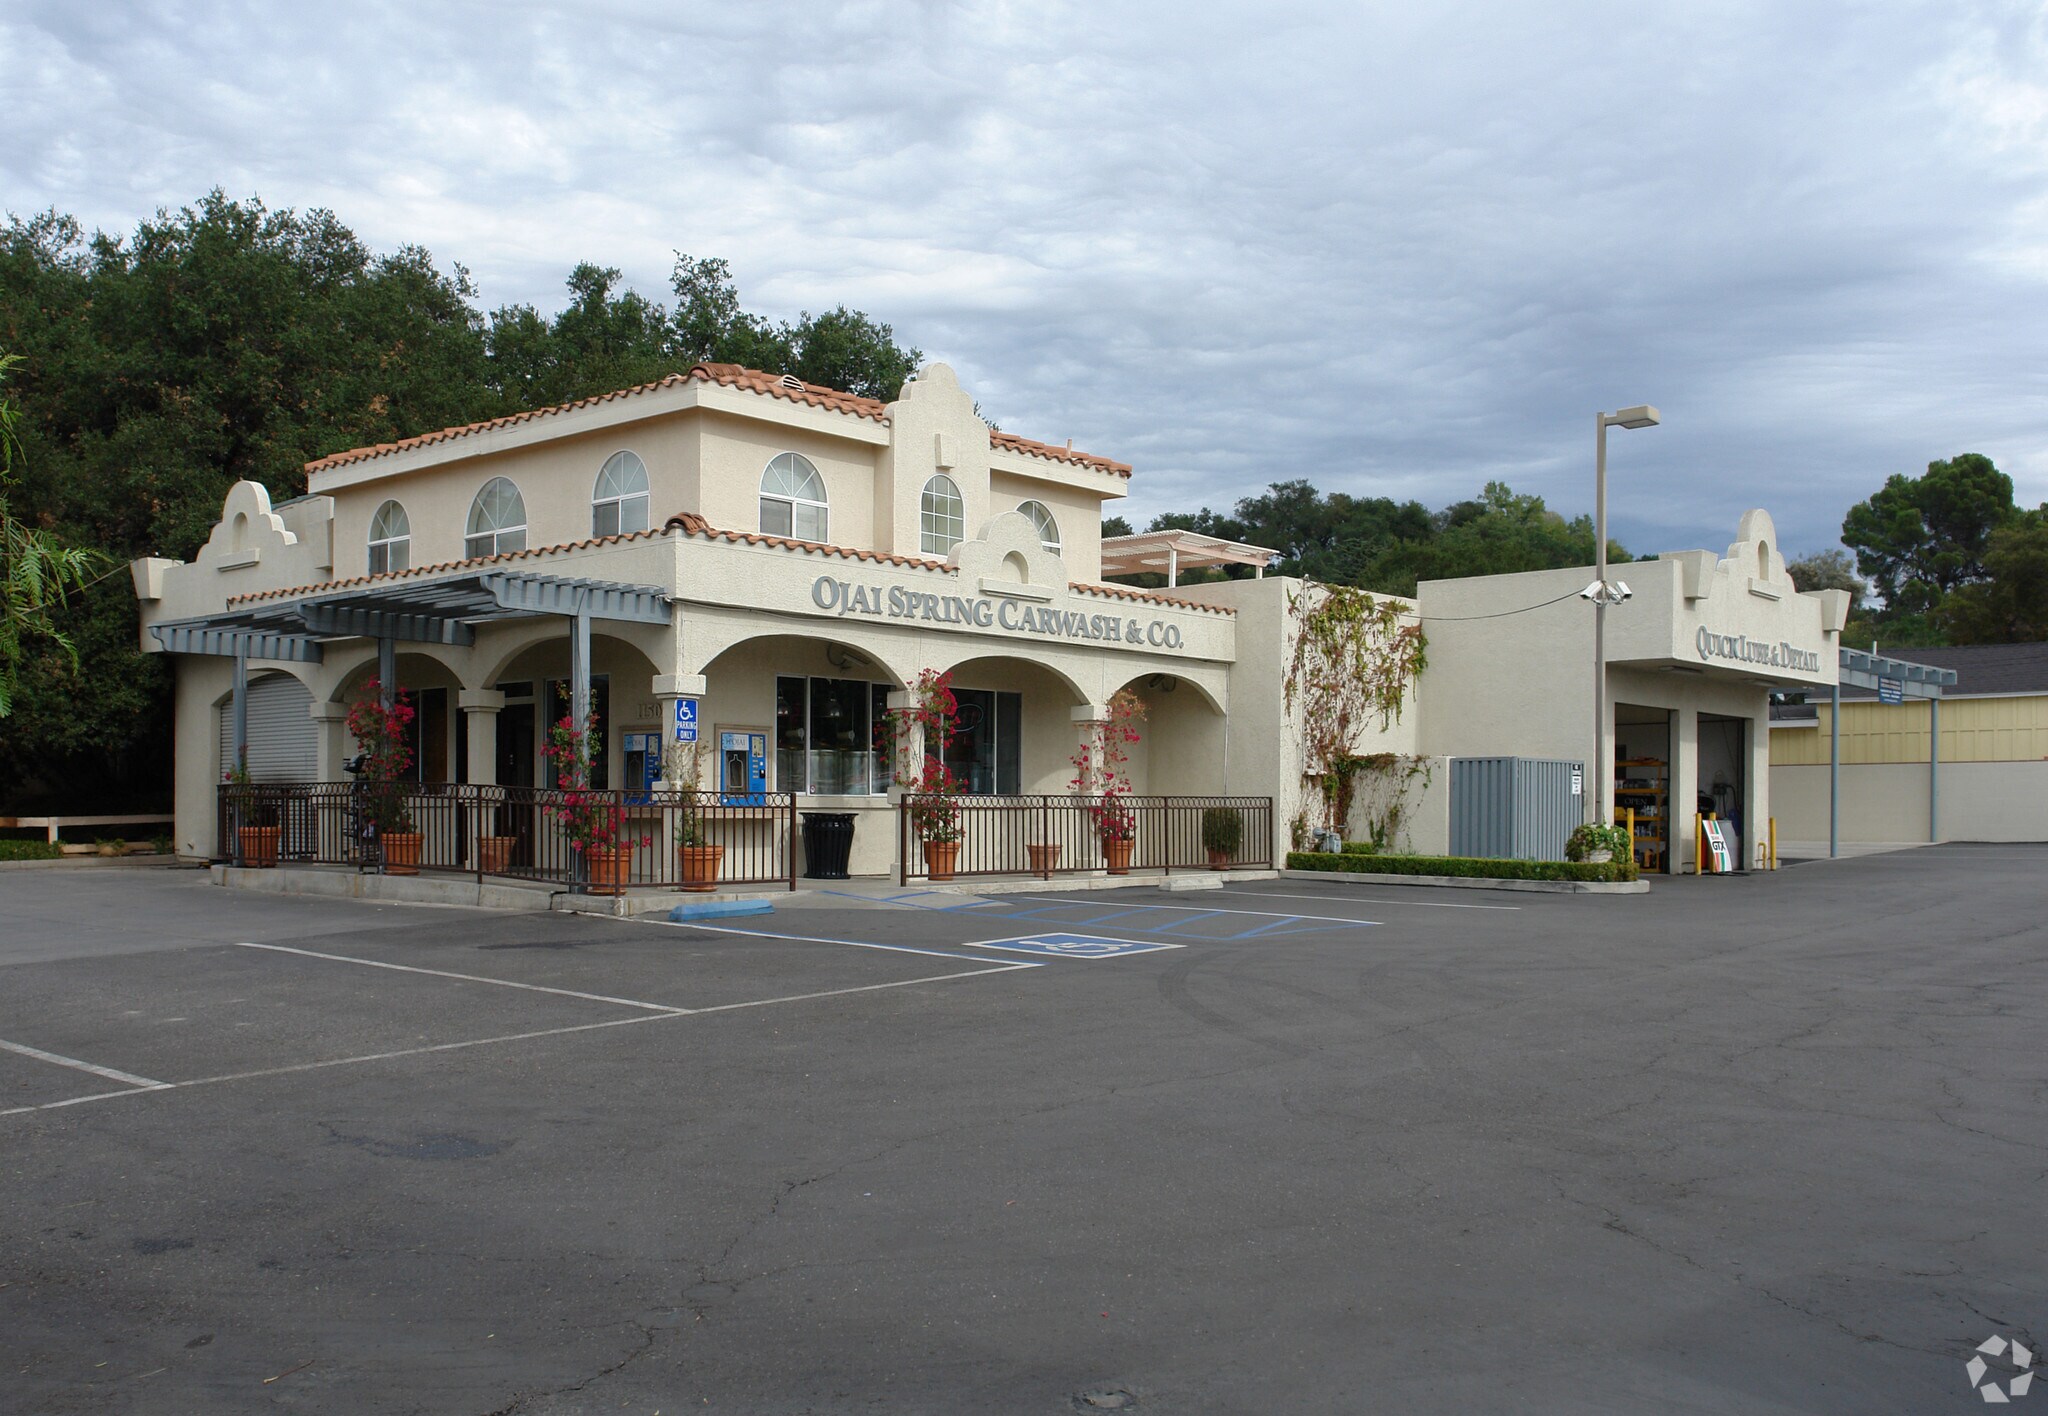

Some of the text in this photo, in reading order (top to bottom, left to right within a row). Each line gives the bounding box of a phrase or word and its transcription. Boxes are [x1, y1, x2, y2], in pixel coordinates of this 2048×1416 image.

[812, 575, 1184, 649] OJAI SPRING CARWASH & CO.
[1696, 625, 1819, 672] QUICK LUBE & DETAIL
[677, 720, 697, 730] PARKING
[680, 730, 693, 740] ONLY
[1712, 840, 1726, 851] GTX
